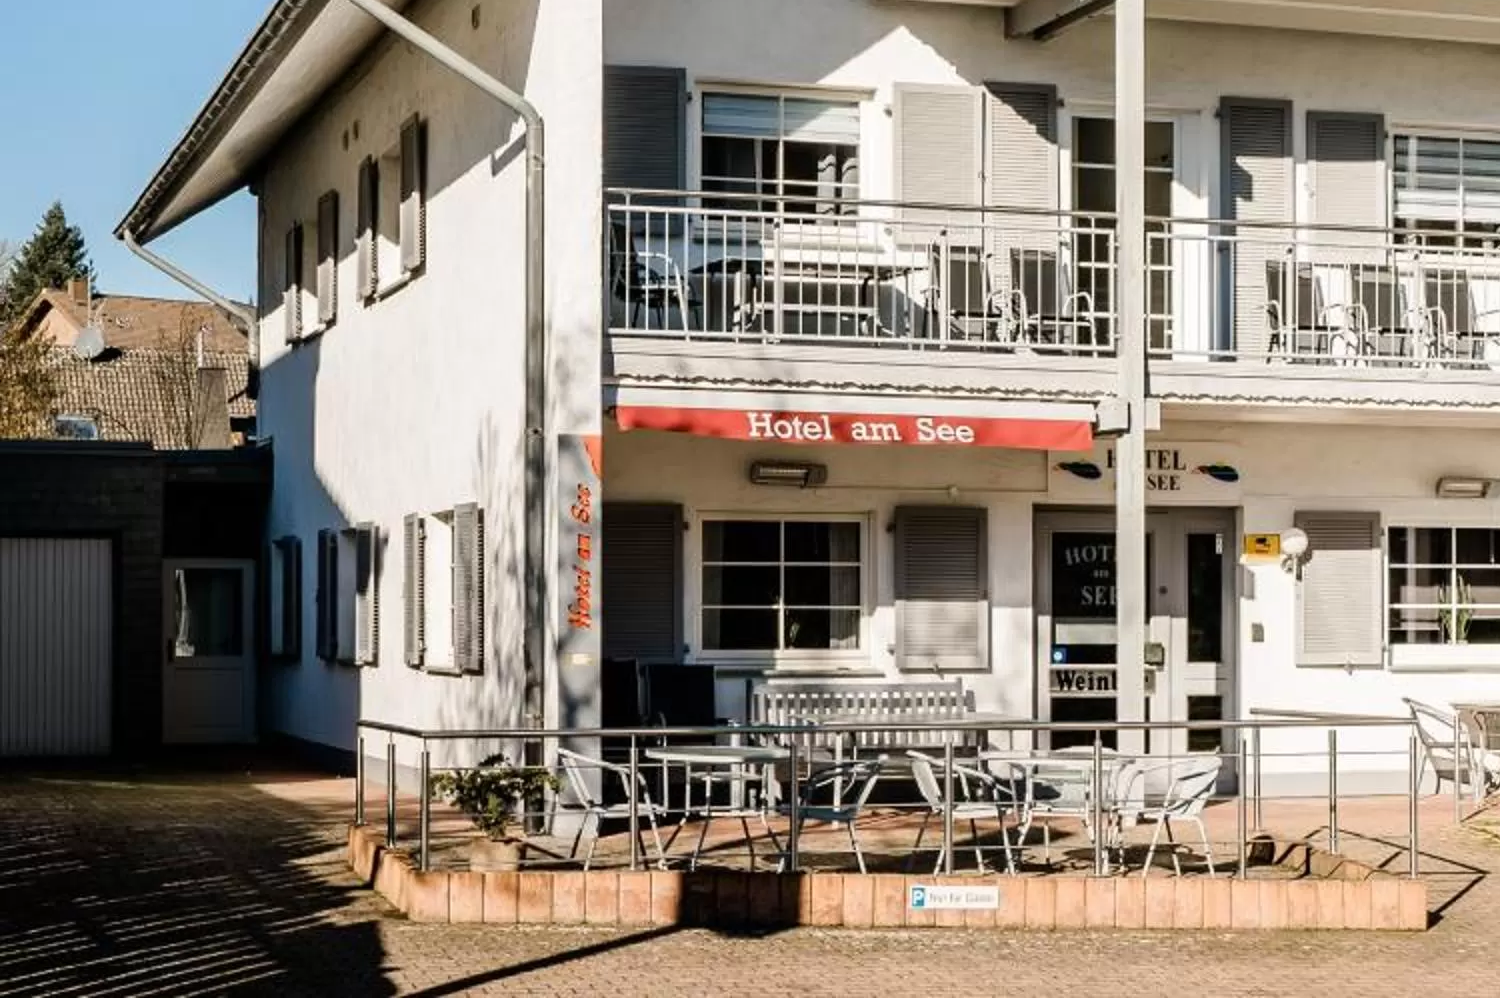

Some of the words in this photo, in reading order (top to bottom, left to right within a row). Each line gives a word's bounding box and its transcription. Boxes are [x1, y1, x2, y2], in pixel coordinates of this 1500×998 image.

[747, 411, 833, 440] Hotel
[851, 422, 902, 442] am
[917, 417, 975, 443] See
[1107, 449, 1187, 471] HTEL
[1146, 474, 1181, 491] SEE
[1065, 545, 1117, 565] HOT
[913, 889, 924, 905] P
